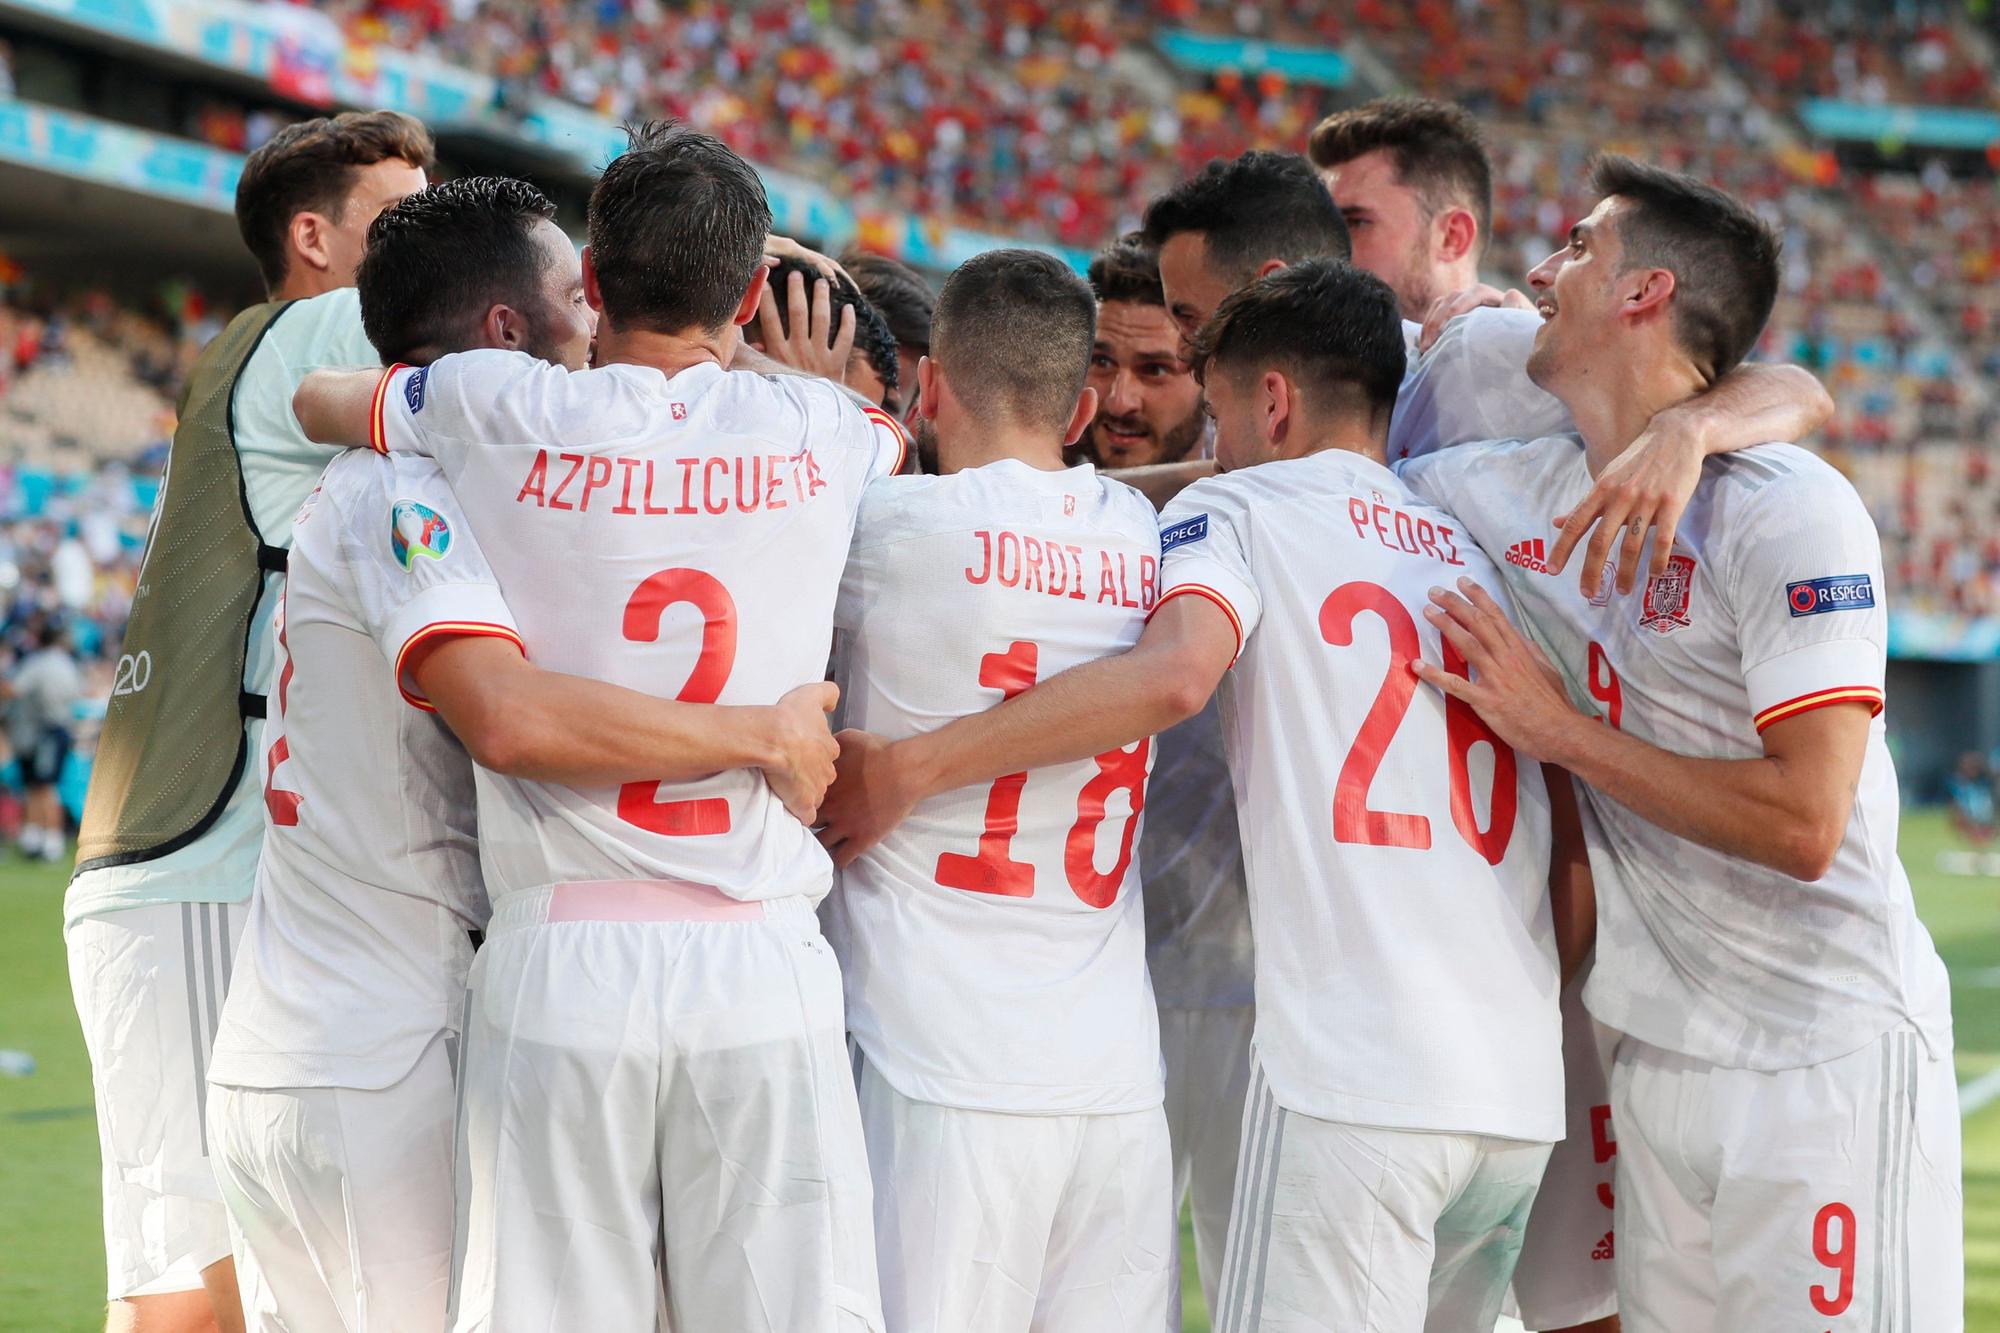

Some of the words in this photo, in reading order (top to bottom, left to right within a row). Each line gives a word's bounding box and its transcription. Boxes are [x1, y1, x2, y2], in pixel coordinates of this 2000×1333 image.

[516, 449, 827, 516] AZPILICUETA
[1162, 520, 1207, 547] SPECT
[1348, 496, 1465, 566] PEDRI
[1504, 551, 1549, 574] adidas
[965, 530, 1086, 601] JORDI
[1097, 550, 1156, 611] ALB
[1818, 584, 1871, 603] RESPECT
[113, 650, 151, 696] 20
[617, 567, 738, 837] 2
[1587, 640, 1622, 731] 9
[1318, 580, 1518, 866] 26
[934, 640, 1150, 909] 18
[1809, 1202, 1856, 1317] 9
